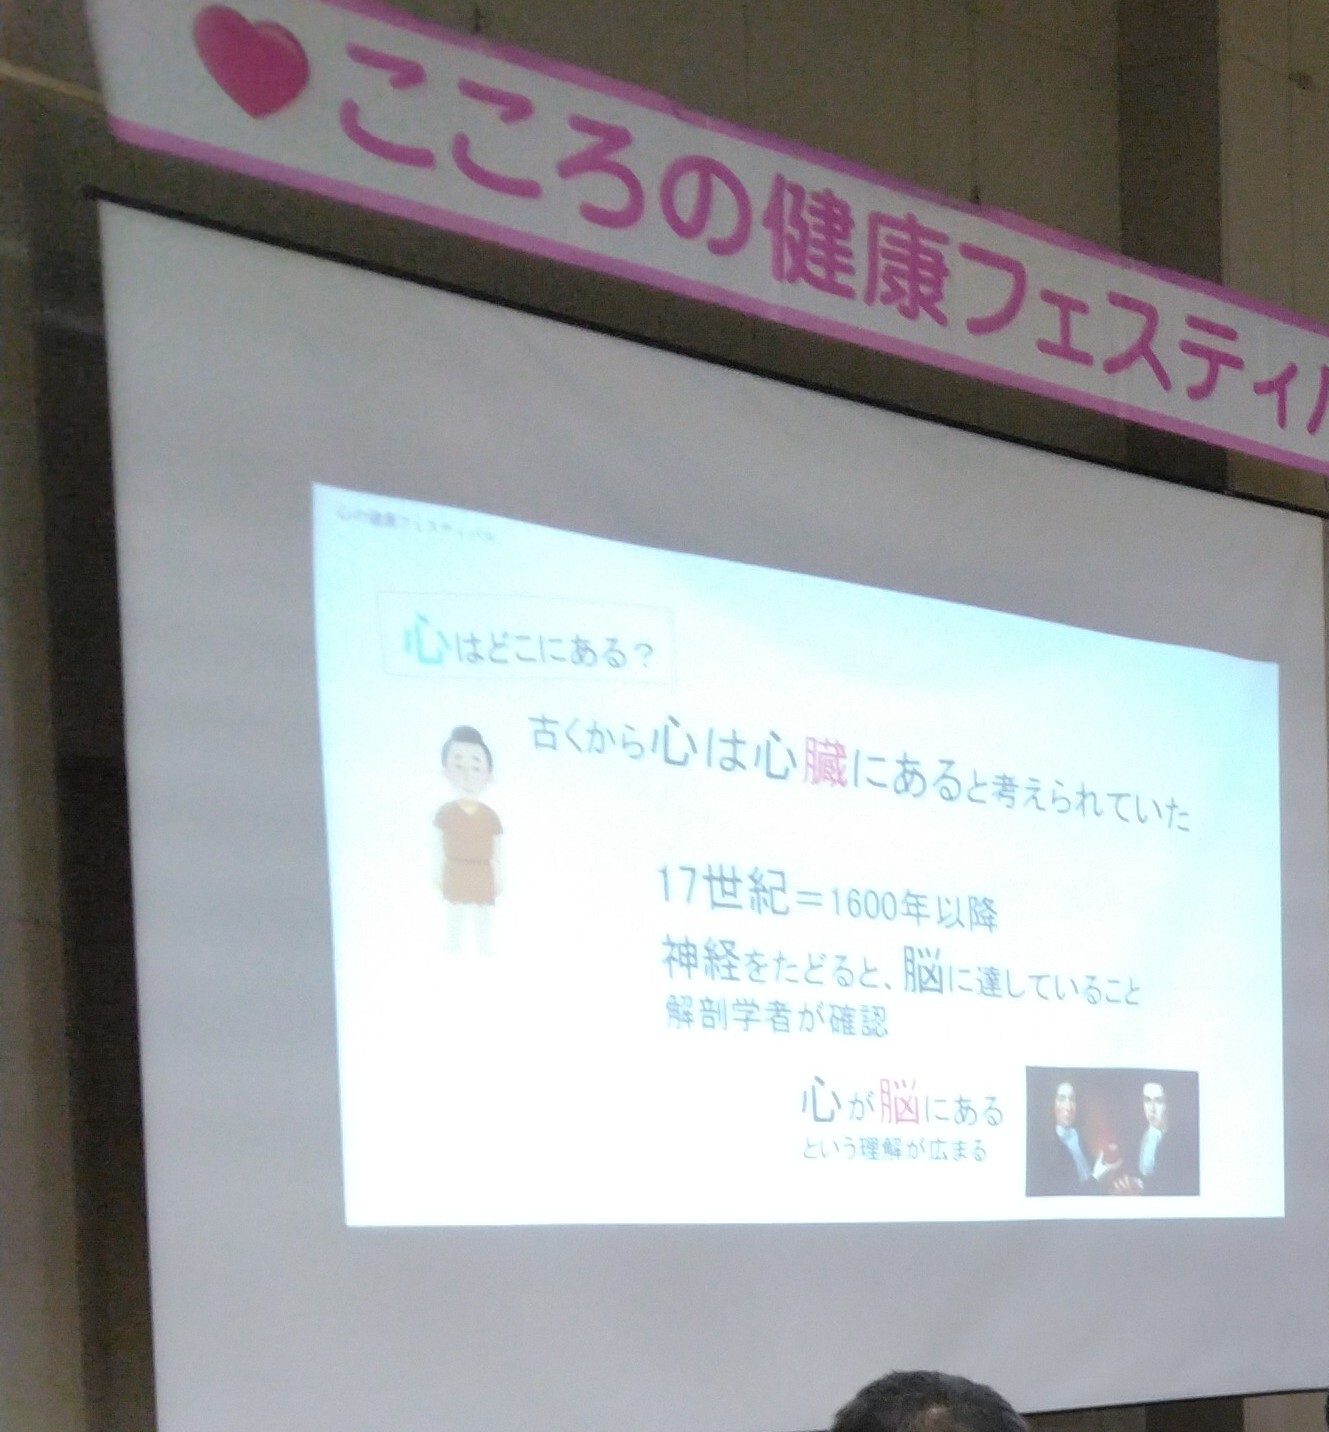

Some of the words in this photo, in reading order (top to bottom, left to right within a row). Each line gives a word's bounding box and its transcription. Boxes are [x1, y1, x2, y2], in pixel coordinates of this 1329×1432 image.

[403, 611, 653, 669] 心はどこにある？
[528, 713, 1190, 832] 古くから心は心臓にあると考えられていた
[665, 995, 889, 1039] 解剖学者が確認
[801, 1074, 1004, 1126] 心が脳にある
[801, 1136, 988, 1163] という理解が広まる
